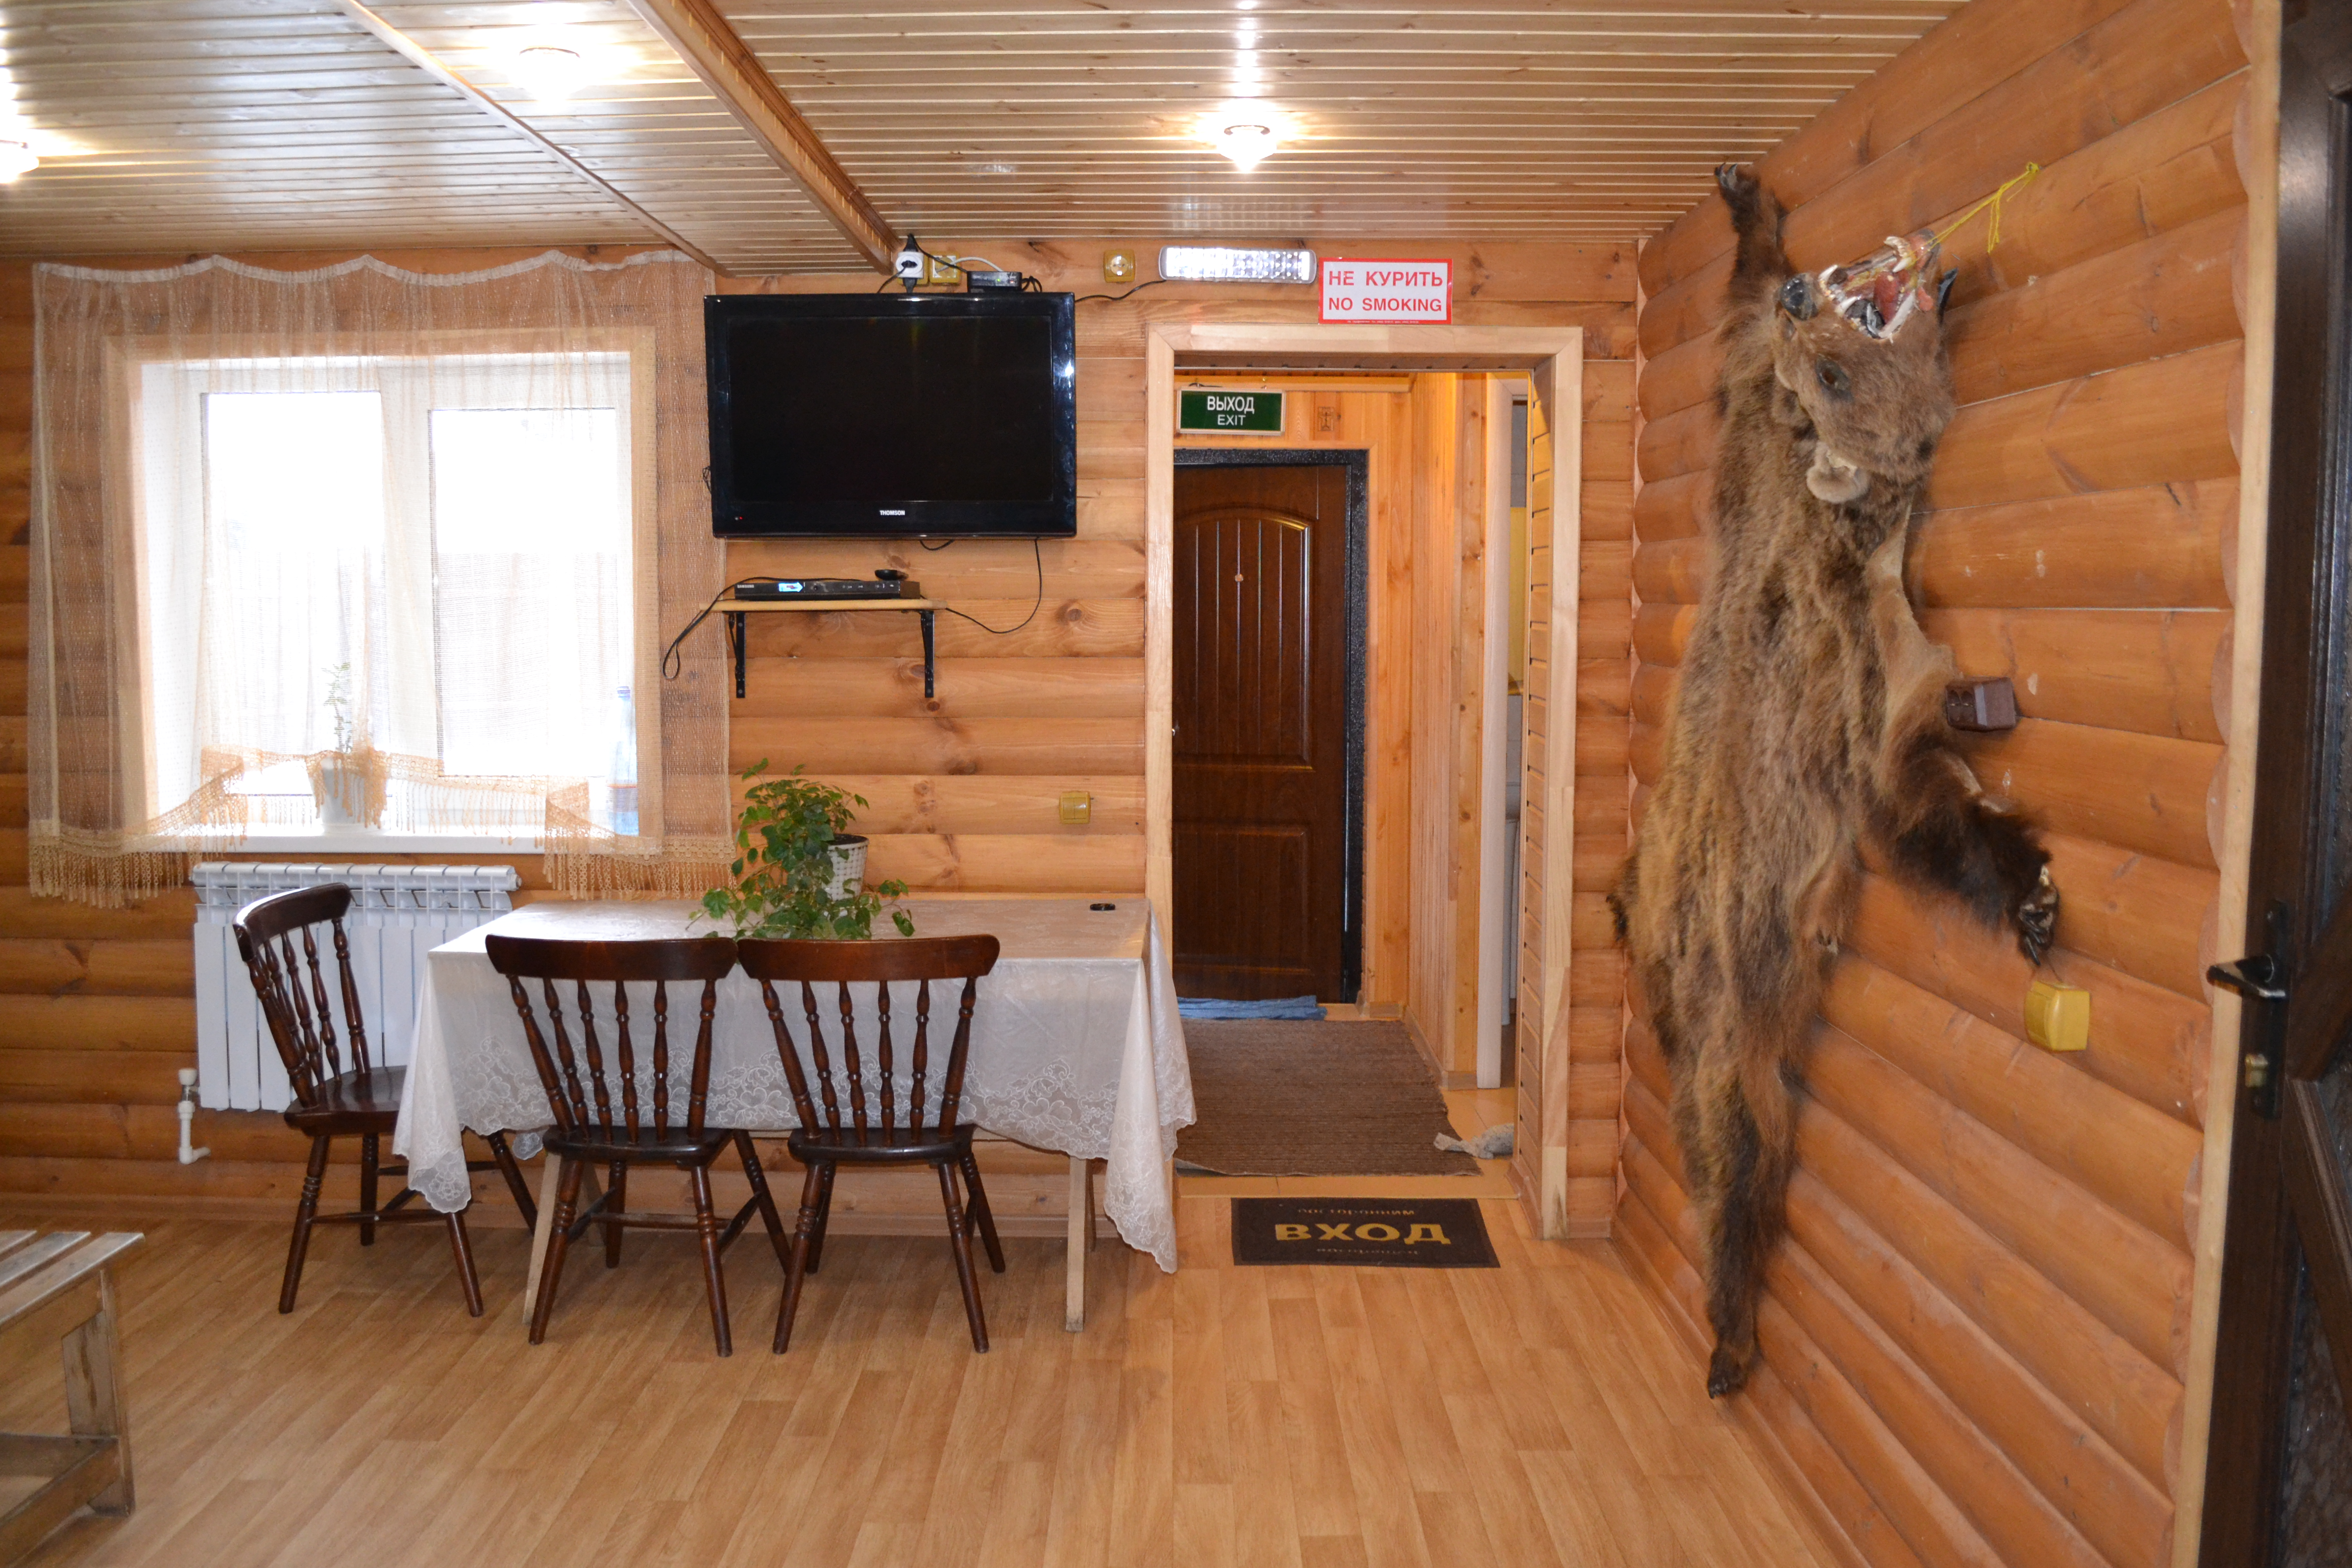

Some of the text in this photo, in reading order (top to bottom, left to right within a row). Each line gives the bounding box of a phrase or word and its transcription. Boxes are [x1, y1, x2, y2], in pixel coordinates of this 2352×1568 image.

[1329, 271, 1443, 287] НЕ КУРИТЬ
[1329, 298, 1441, 311] NO SMOKING
[1207, 396, 1255, 414] ВЫХОД
[1217, 414, 1246, 426] EXIT
[1275, 1223, 1452, 1244] ВХОД
